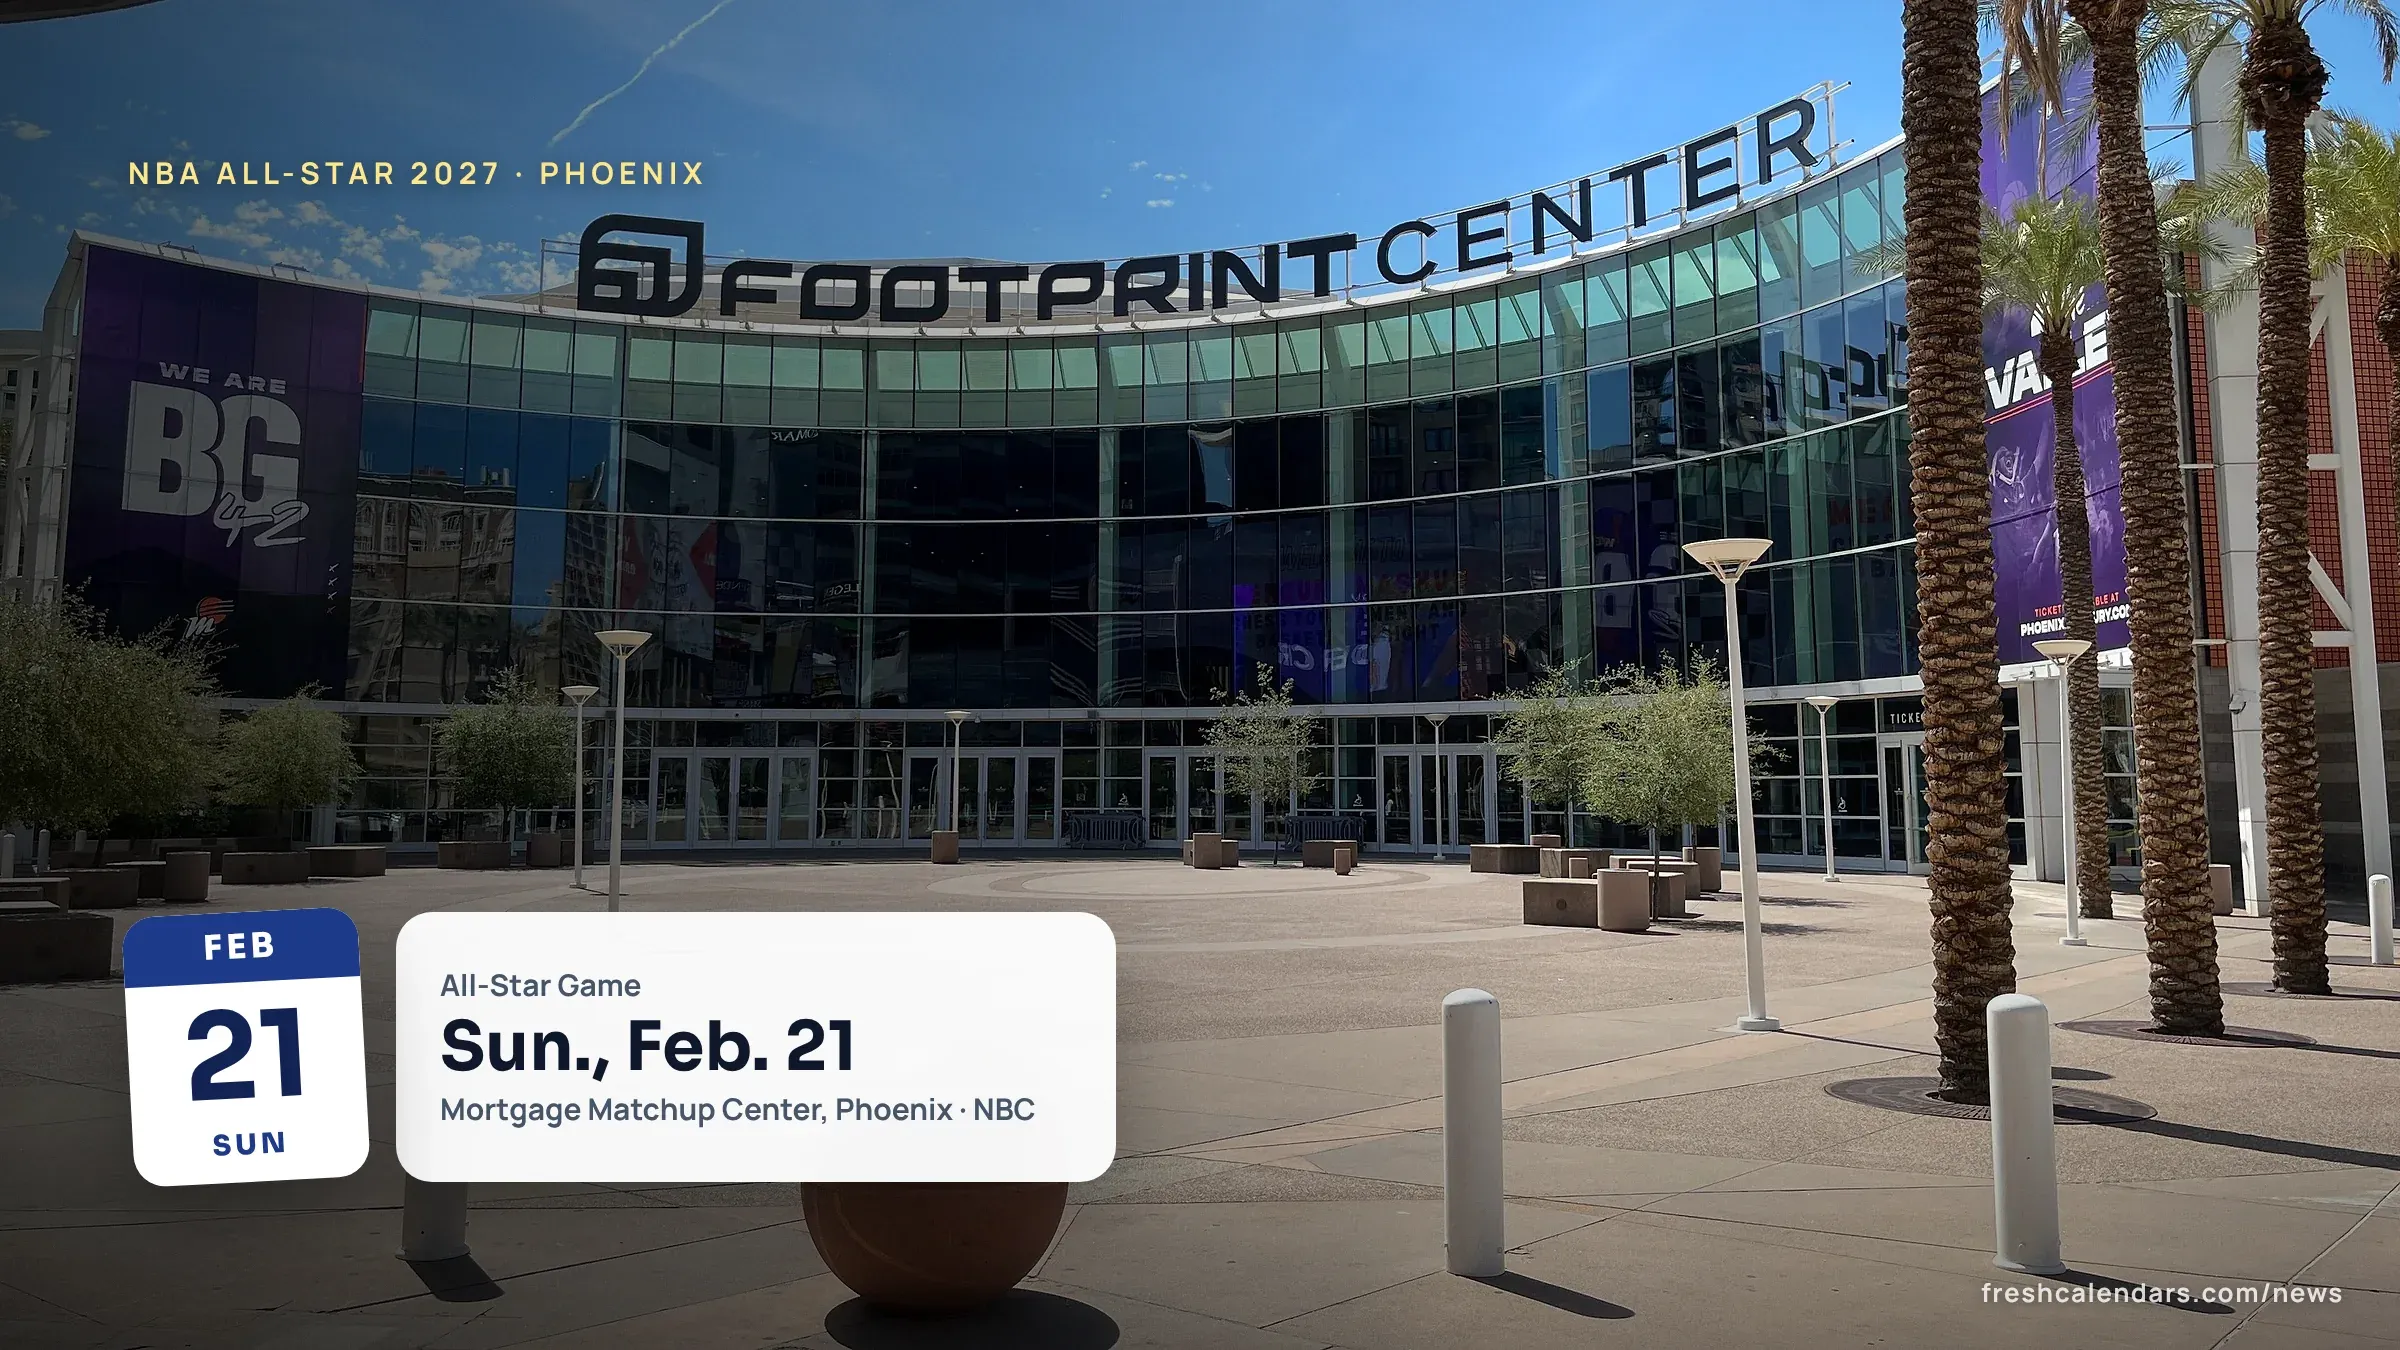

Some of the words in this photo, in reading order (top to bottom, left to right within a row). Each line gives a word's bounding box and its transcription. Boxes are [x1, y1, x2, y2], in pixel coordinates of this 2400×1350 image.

[720, 233, 1357, 322] FOOTPRINT
[1377, 97, 1819, 285] CENTER
[158, 360, 211, 385] WE
[223, 371, 288, 395] ARE
[121, 379, 302, 517] BG
[212, 491, 311, 549] 42
[2034, 603, 2064, 618] TICKET
[2110, 591, 2120, 603] AT
